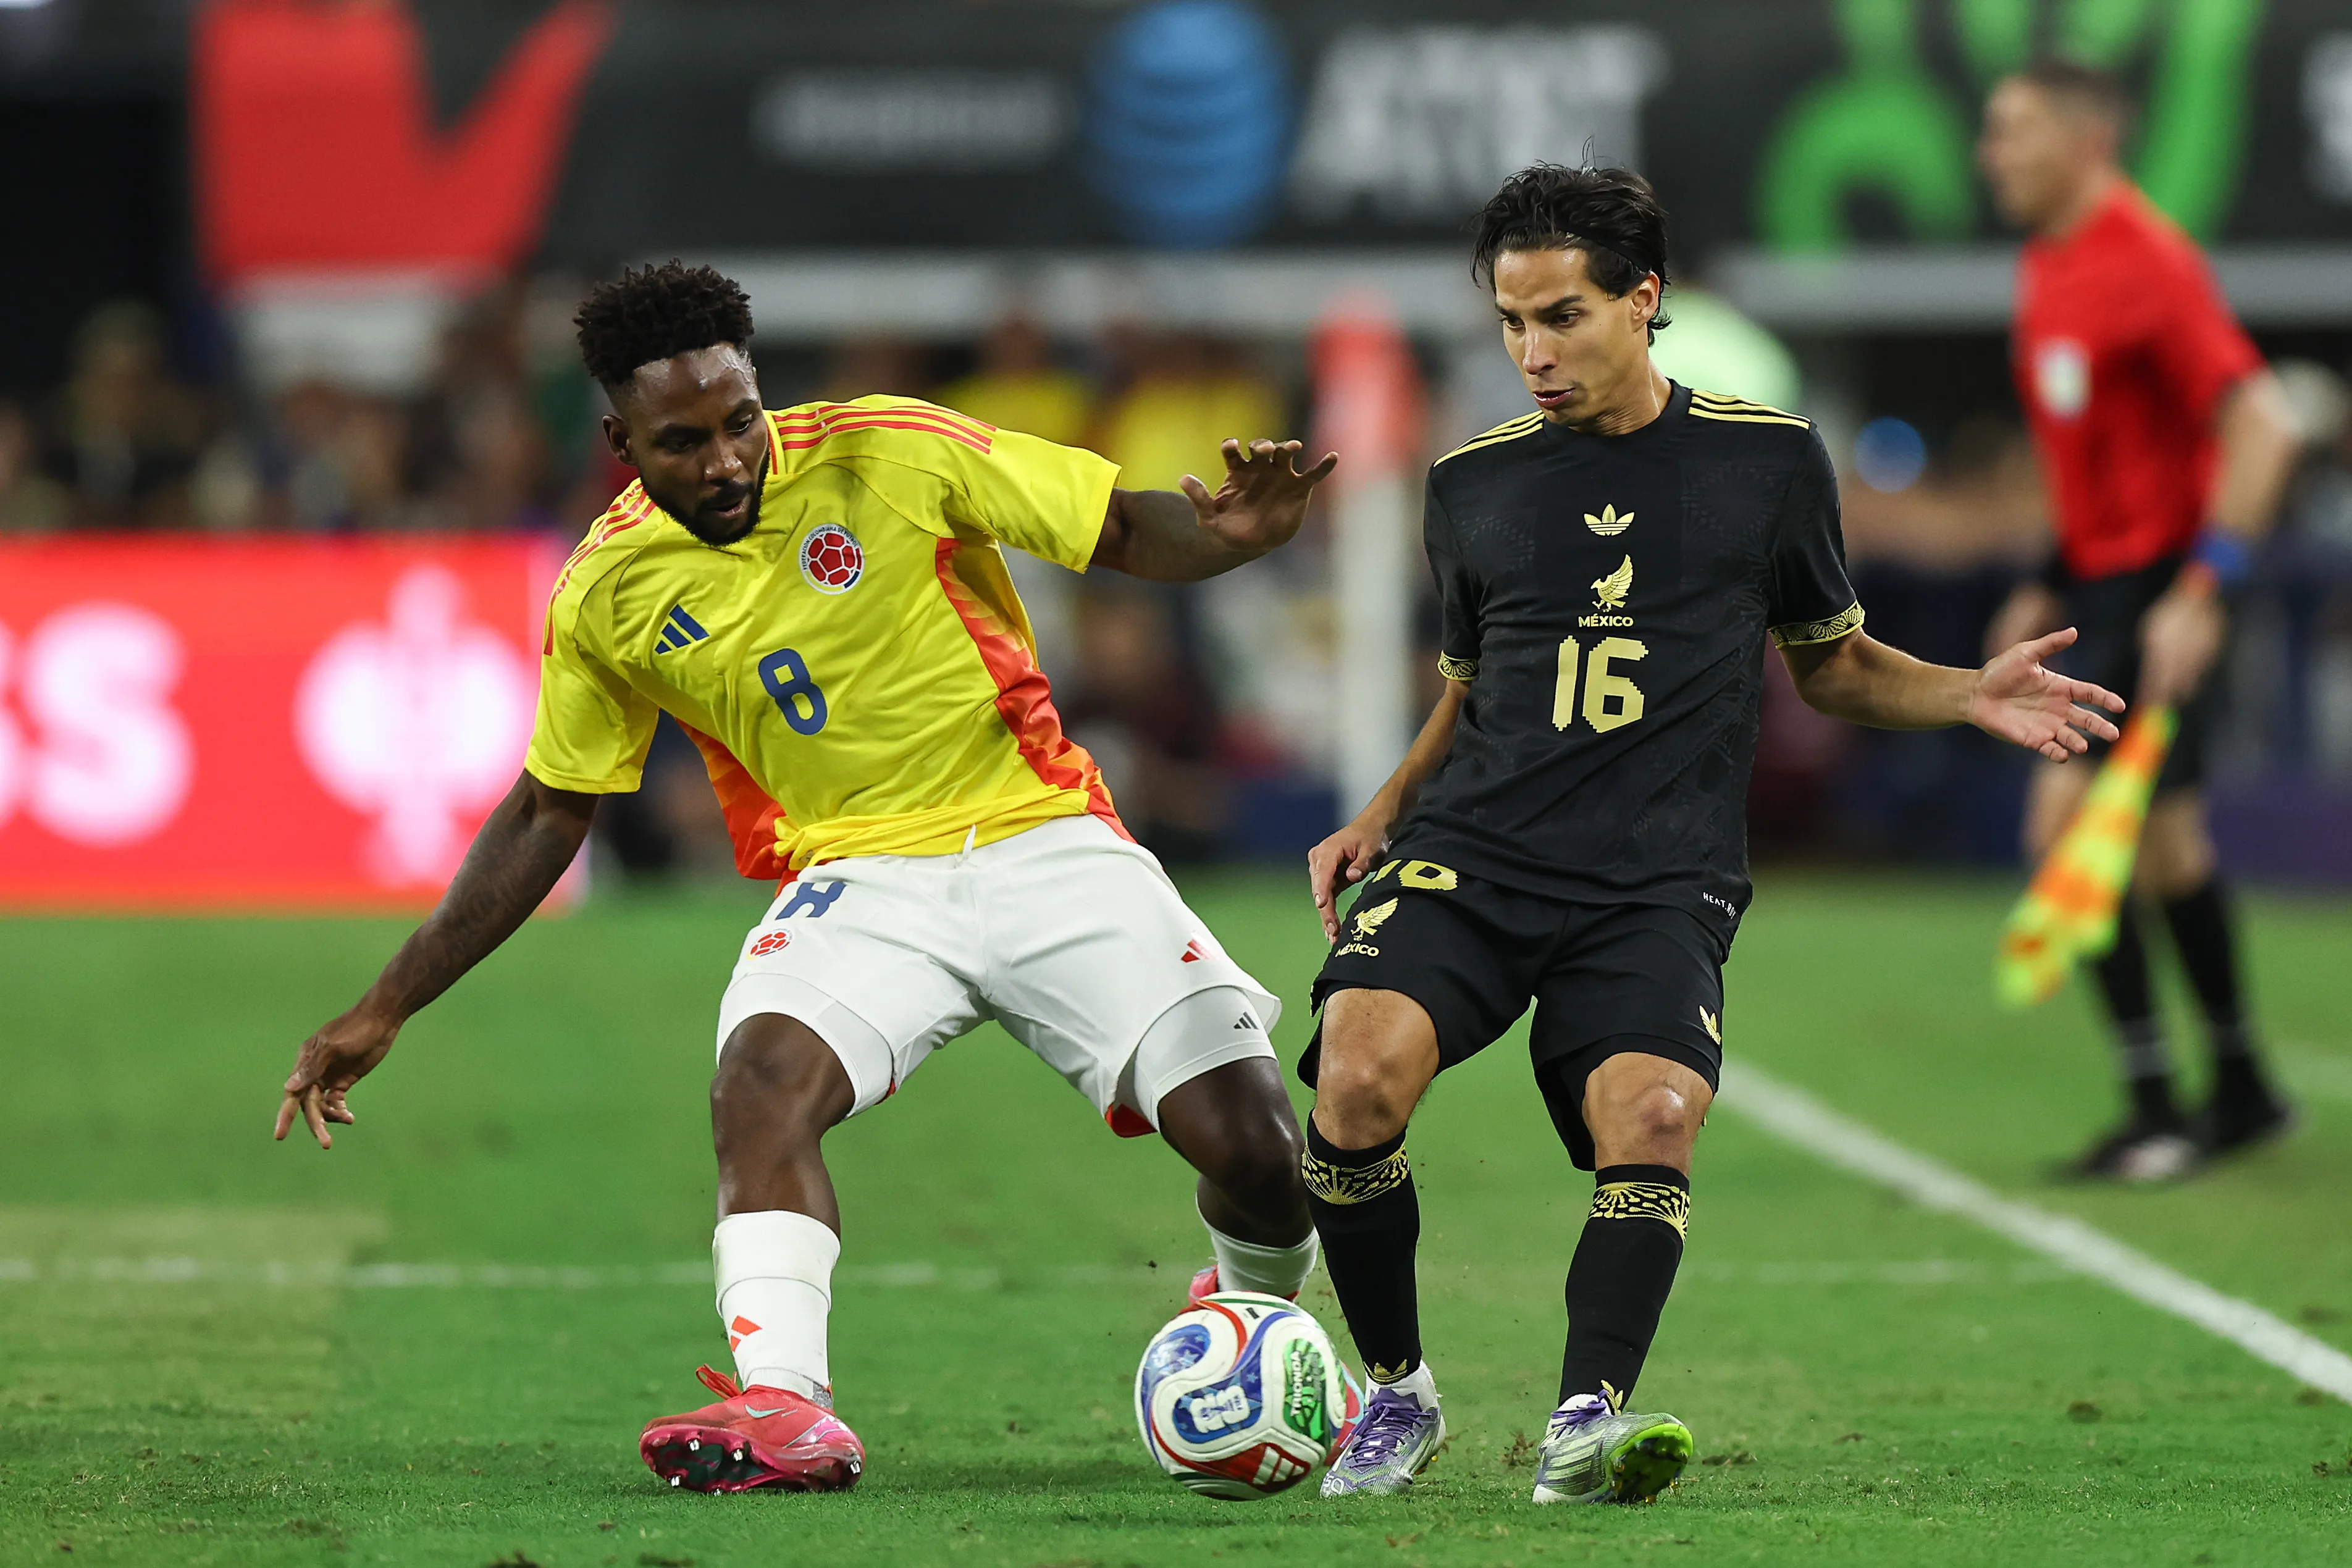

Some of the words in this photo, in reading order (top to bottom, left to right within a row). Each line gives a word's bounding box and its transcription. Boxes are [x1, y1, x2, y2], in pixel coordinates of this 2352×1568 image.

[1578, 613, 1634, 627] MÉXICO
[758, 647, 828, 736] 8
[1552, 635, 1649, 734] 16
[1335, 942, 1380, 958] MÉXICO
